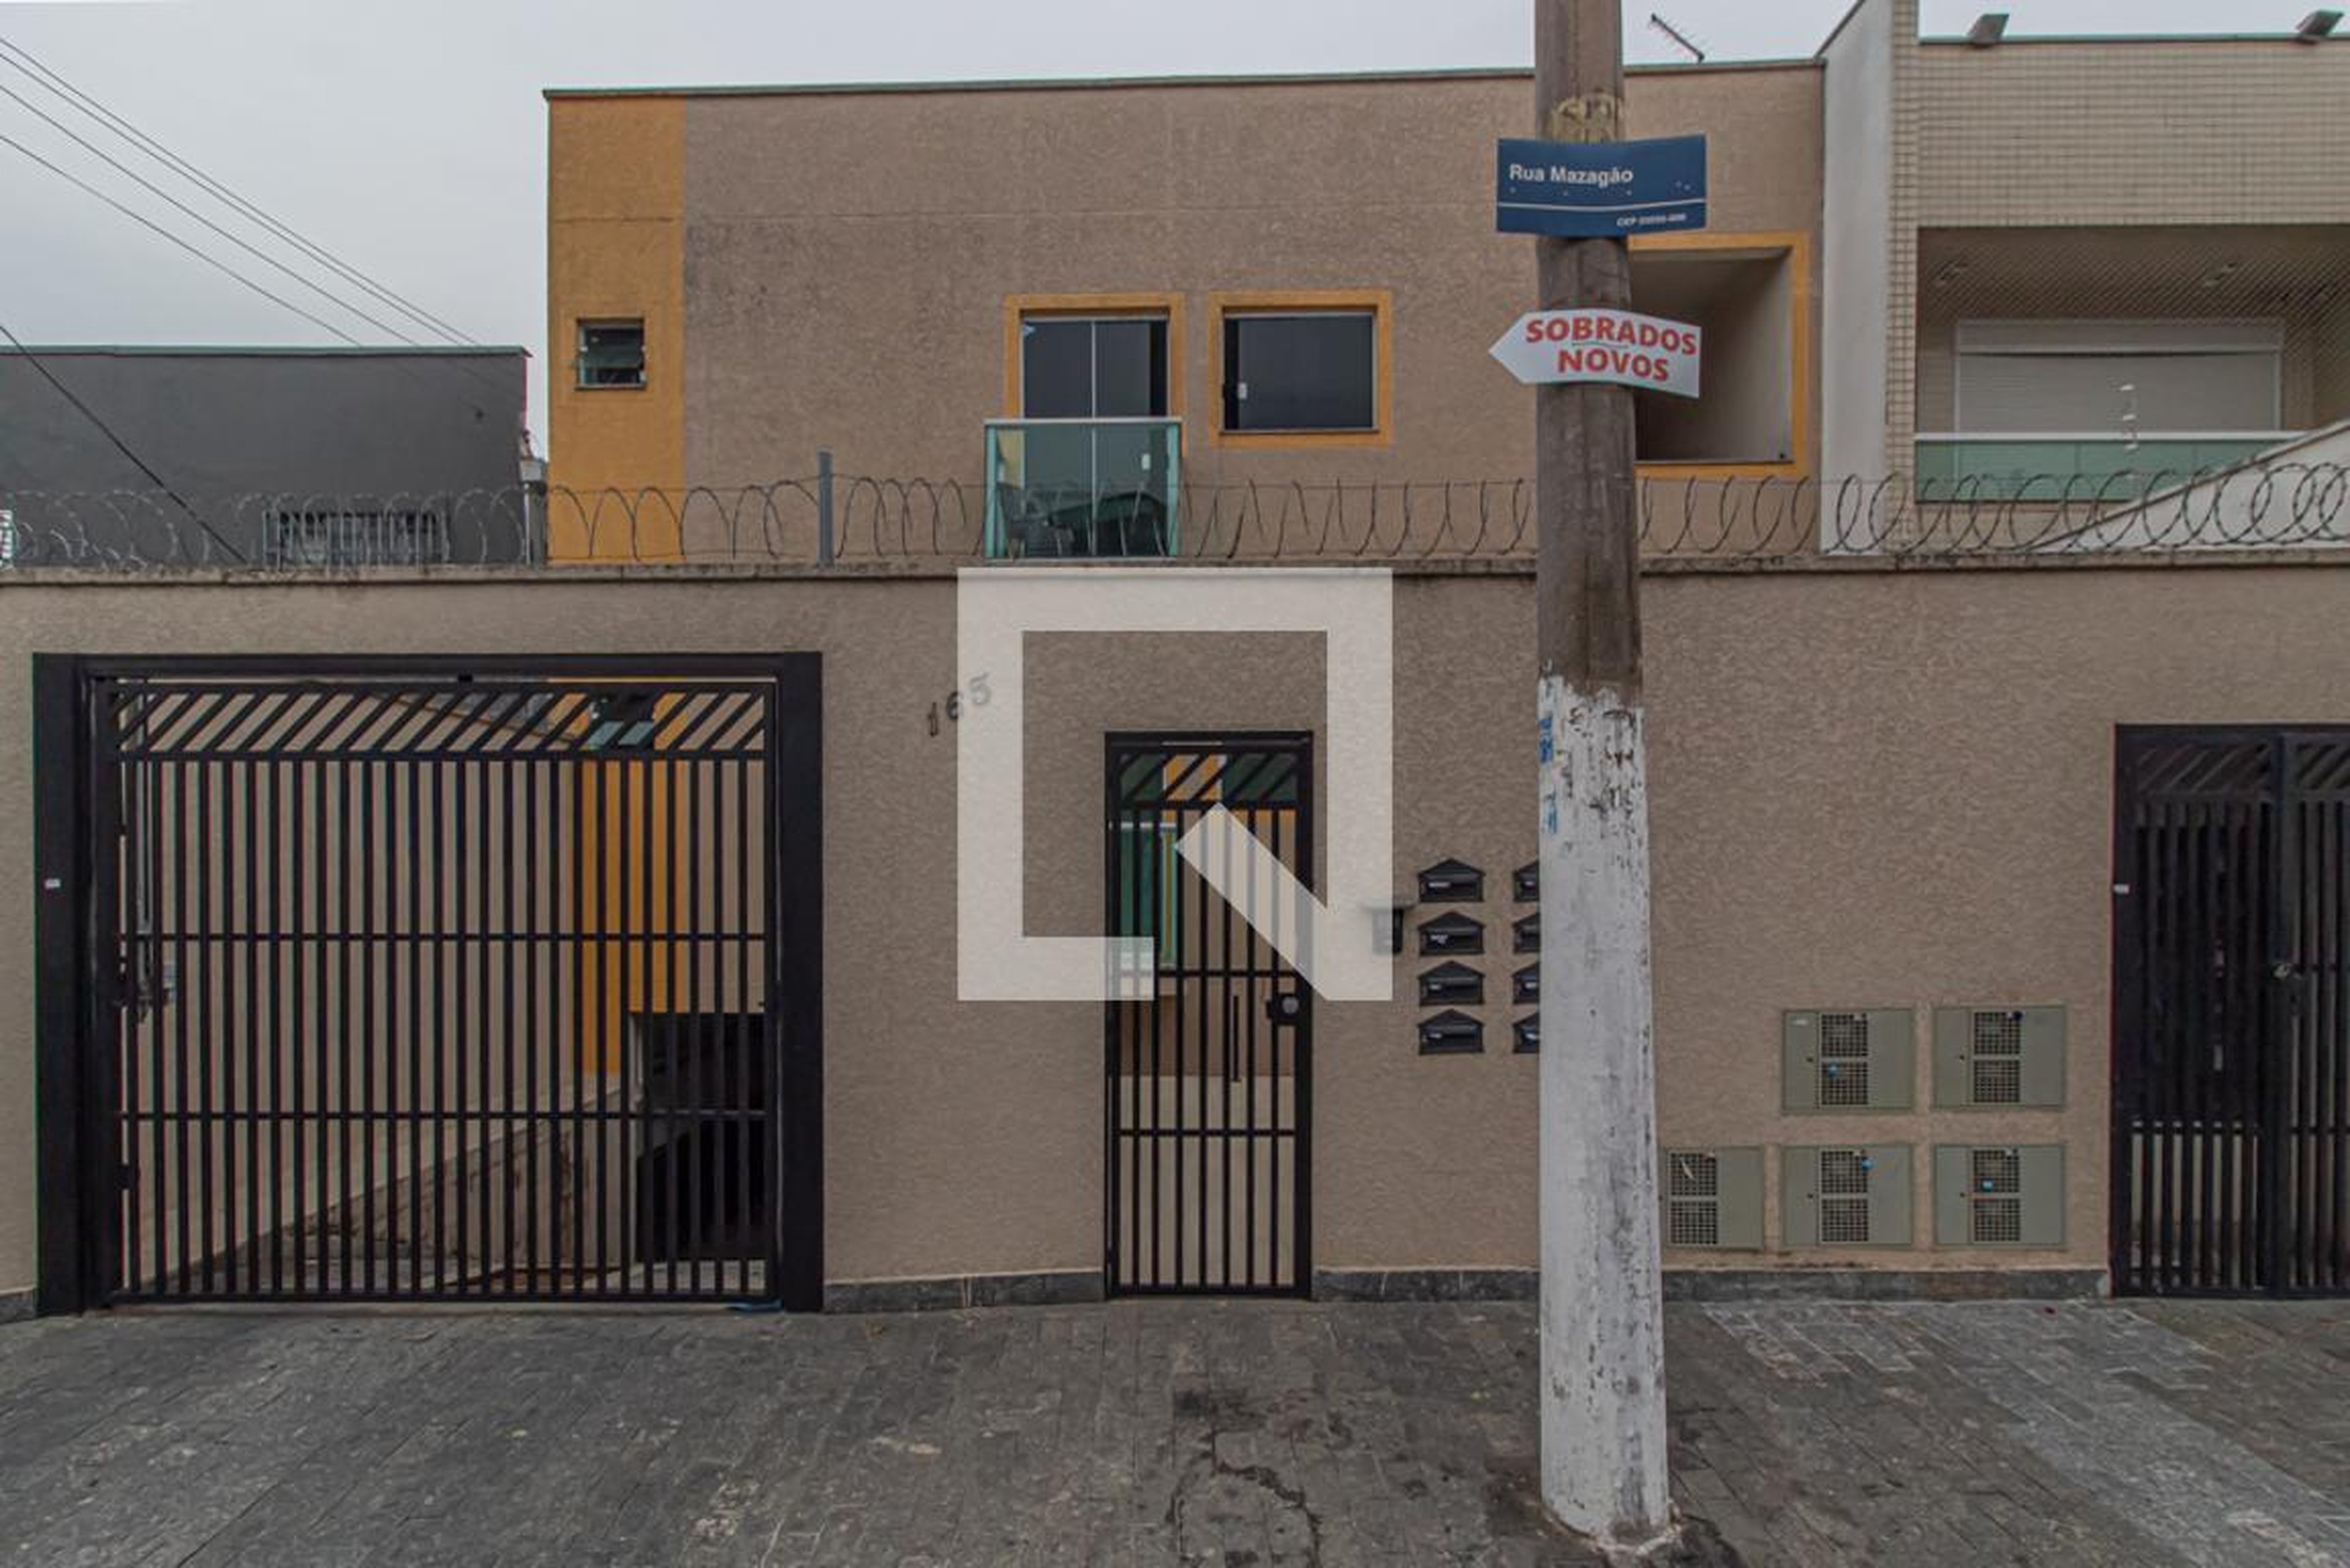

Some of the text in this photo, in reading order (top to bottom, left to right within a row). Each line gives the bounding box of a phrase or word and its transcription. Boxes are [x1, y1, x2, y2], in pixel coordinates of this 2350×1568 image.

[1509, 163, 1633, 189] Rua Mazagão
[1526, 316, 1697, 356] SOBRADOS
[1557, 348, 1669, 381] NOVOS
